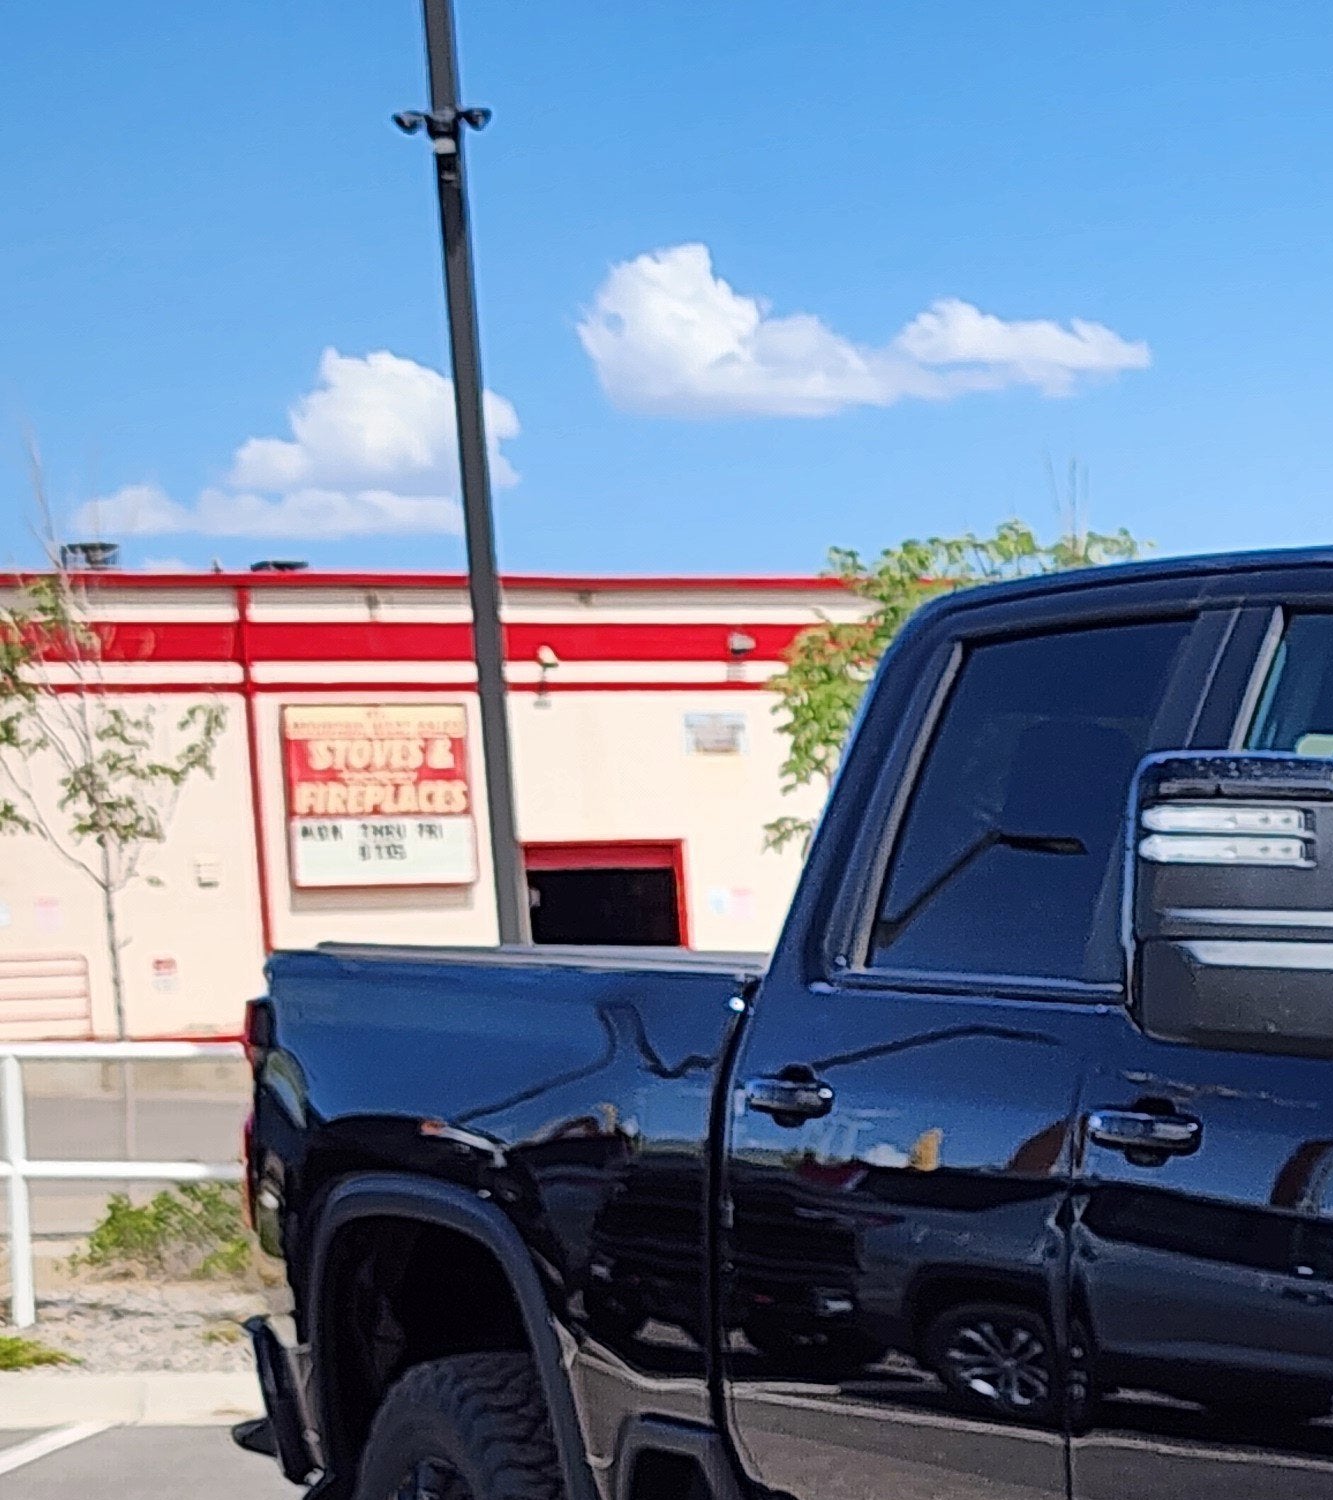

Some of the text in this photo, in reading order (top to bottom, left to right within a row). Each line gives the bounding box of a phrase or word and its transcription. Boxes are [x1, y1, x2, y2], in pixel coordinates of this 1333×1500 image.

[308, 736, 455, 770] STOVES &
[294, 778, 468, 815] FIREPLACES
